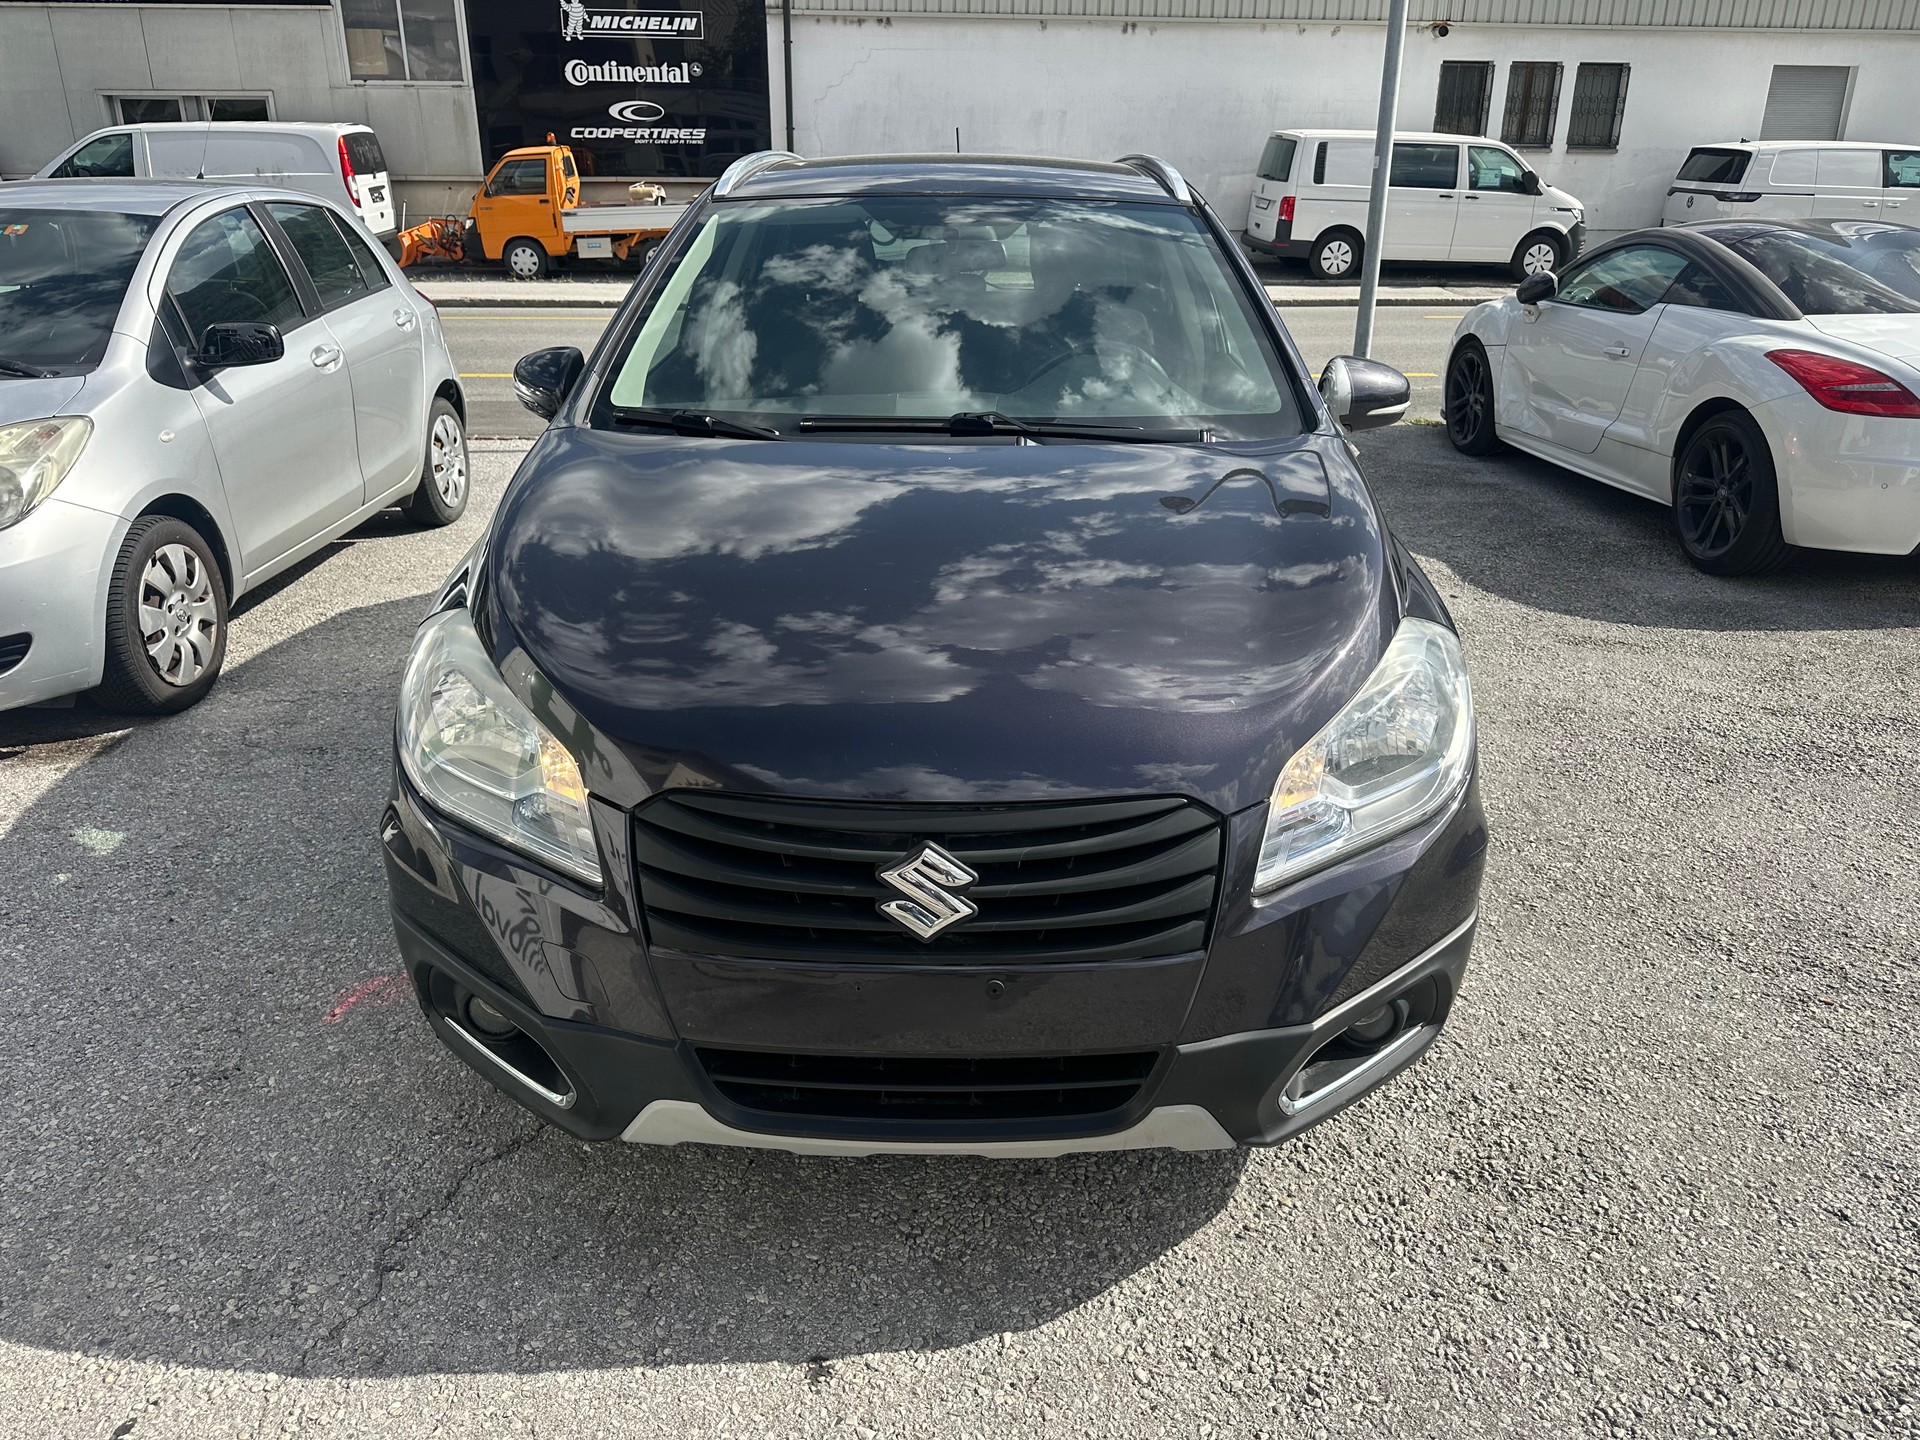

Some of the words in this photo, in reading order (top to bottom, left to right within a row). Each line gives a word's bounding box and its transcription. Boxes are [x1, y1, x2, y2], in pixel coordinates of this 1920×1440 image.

[590, 15, 698, 31] MICHELIN
[564, 59, 690, 86] Continental
[570, 127, 707, 139] COOPERTIRES
